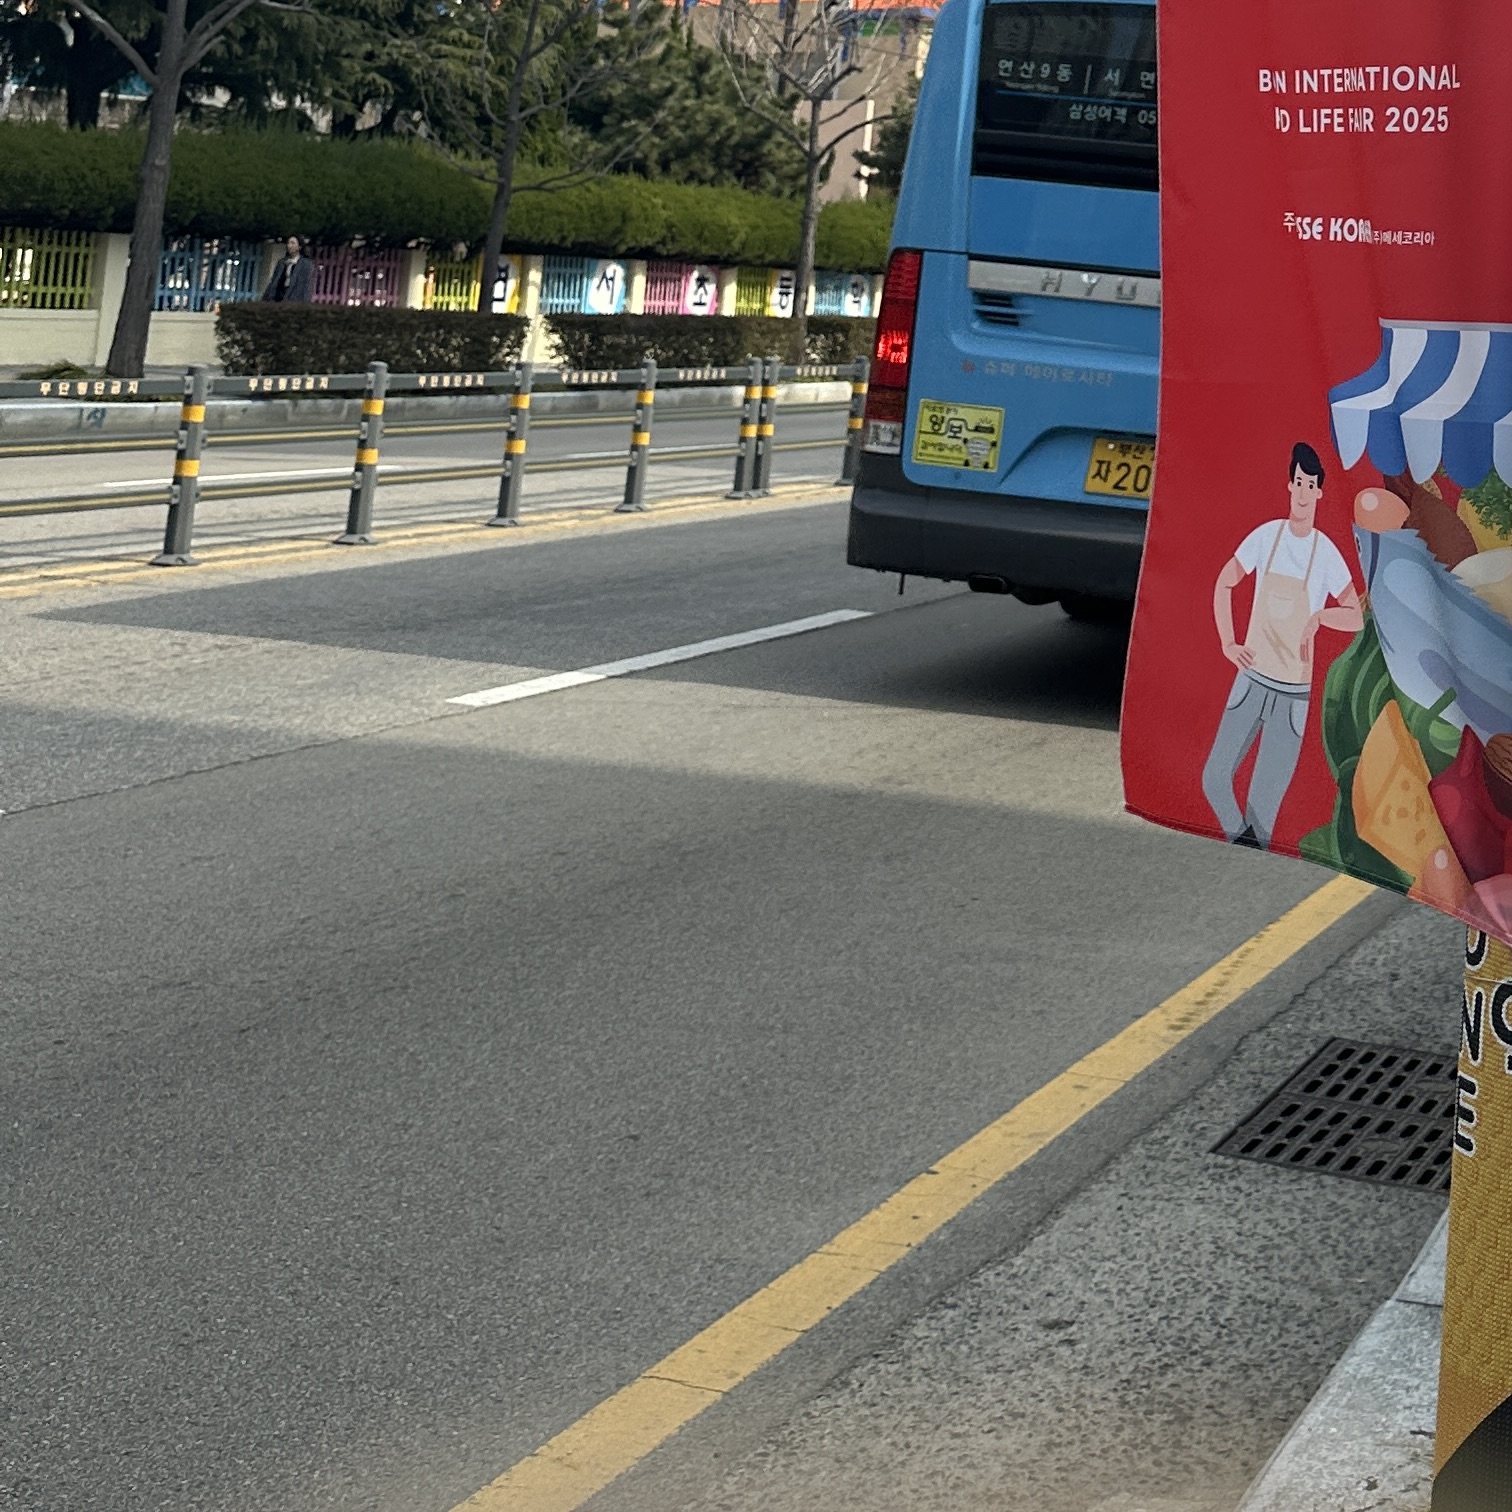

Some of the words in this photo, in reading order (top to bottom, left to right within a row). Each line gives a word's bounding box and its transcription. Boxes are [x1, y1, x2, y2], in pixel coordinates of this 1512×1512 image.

[1298, 108, 1345, 134] LIFE
[1384, 105, 1450, 134] 2025
[1040, 269, 1161, 305] HYU
